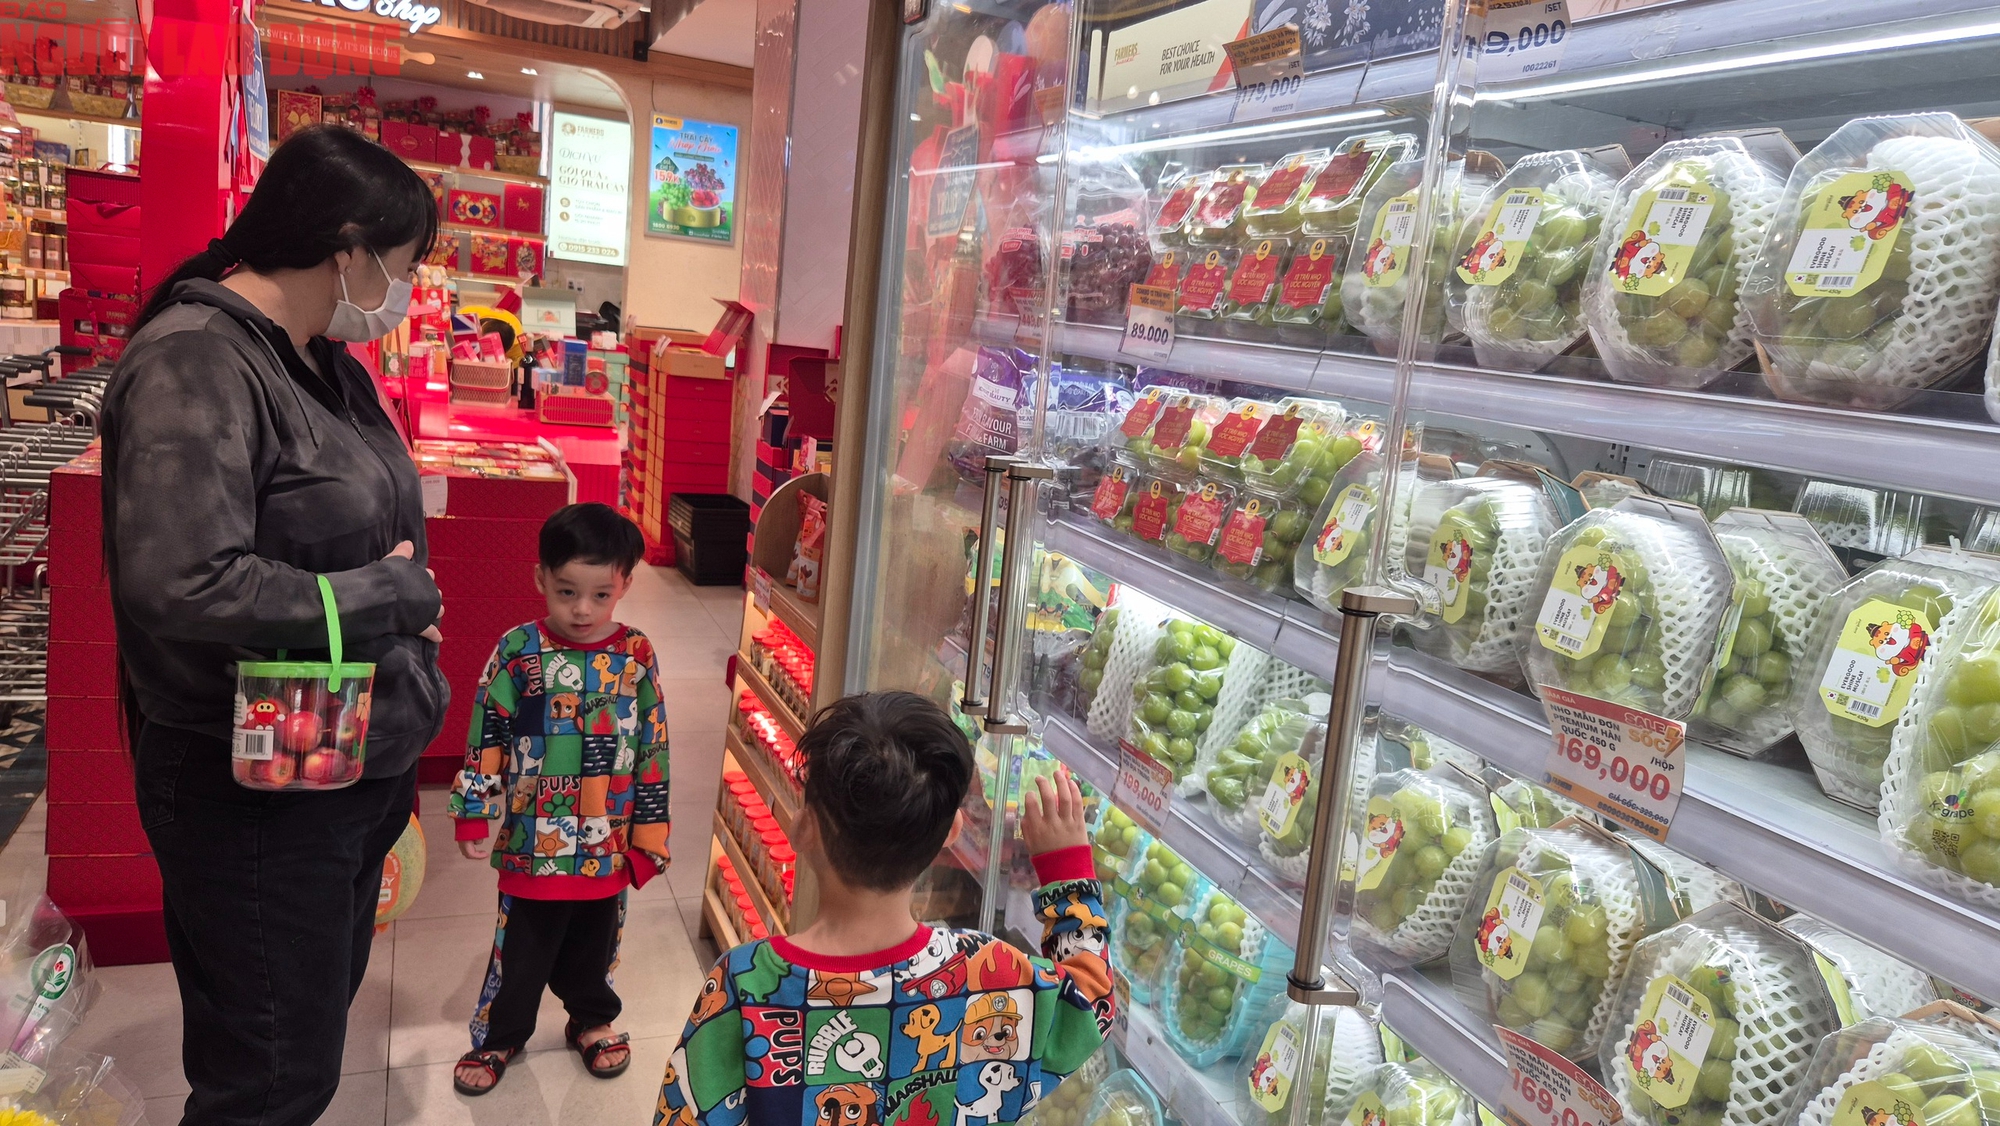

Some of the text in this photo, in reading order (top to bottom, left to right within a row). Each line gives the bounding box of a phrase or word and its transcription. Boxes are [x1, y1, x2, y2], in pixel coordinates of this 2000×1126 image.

[375, 0, 440, 34] Shop
[267, 29, 295, 43] SWEET,
[297, 34, 311, 45] IT'S
[313, 36, 343, 50] FLUFFY,
[359, 44, 398, 59] DELICIOUS
[1162, 40, 1201, 61] BEST CHOICE
[1159, 51, 1215, 76] FOR YOUR HEALTH
[1522, 60, 1557, 73] 10022261
[1241, 74, 1301, 104] 179,000
[1810, 236, 1827, 269] EVERGOOD
[1131, 322, 1169, 346] 89.000
[522, 654, 544, 697] PUPS
[544, 652, 568, 689] RUBBLE
[1841, 659, 1856, 689] EVERGOOD
[1846, 674, 1857, 691] SHINE
[1852, 670, 1864, 693] MUSCAT
[1550, 704, 1620, 732] NHO MẪU ĐƠN
[1553, 713, 1621, 743] PREMIUM HÀN
[1624, 712, 1666, 736] SALE
[1561, 724, 1616, 752] QUỐC 450 G
[1555, 732, 1671, 801] 169,000
[1650, 756, 1675, 772] /HỘP
[539, 775, 581, 798] PUPS
[1123, 771, 1162, 812] 199,000
[1207, 950, 1252, 977] GRAPES
[1678, 1014, 1690, 1037] MUSCAT
[1684, 1017, 1693, 1034] SHINE
[1684, 1020, 1698, 1050] EVERGOOD
[759, 1010, 802, 1086] PUPS
[806, 1009, 858, 1076] RUBBLE
[1505, 1042, 1526, 1057] NHO
[1508, 1050, 1572, 1096] PREMIUM HÀN
[1516, 1062, 1567, 1103] QUỐC 450 G
